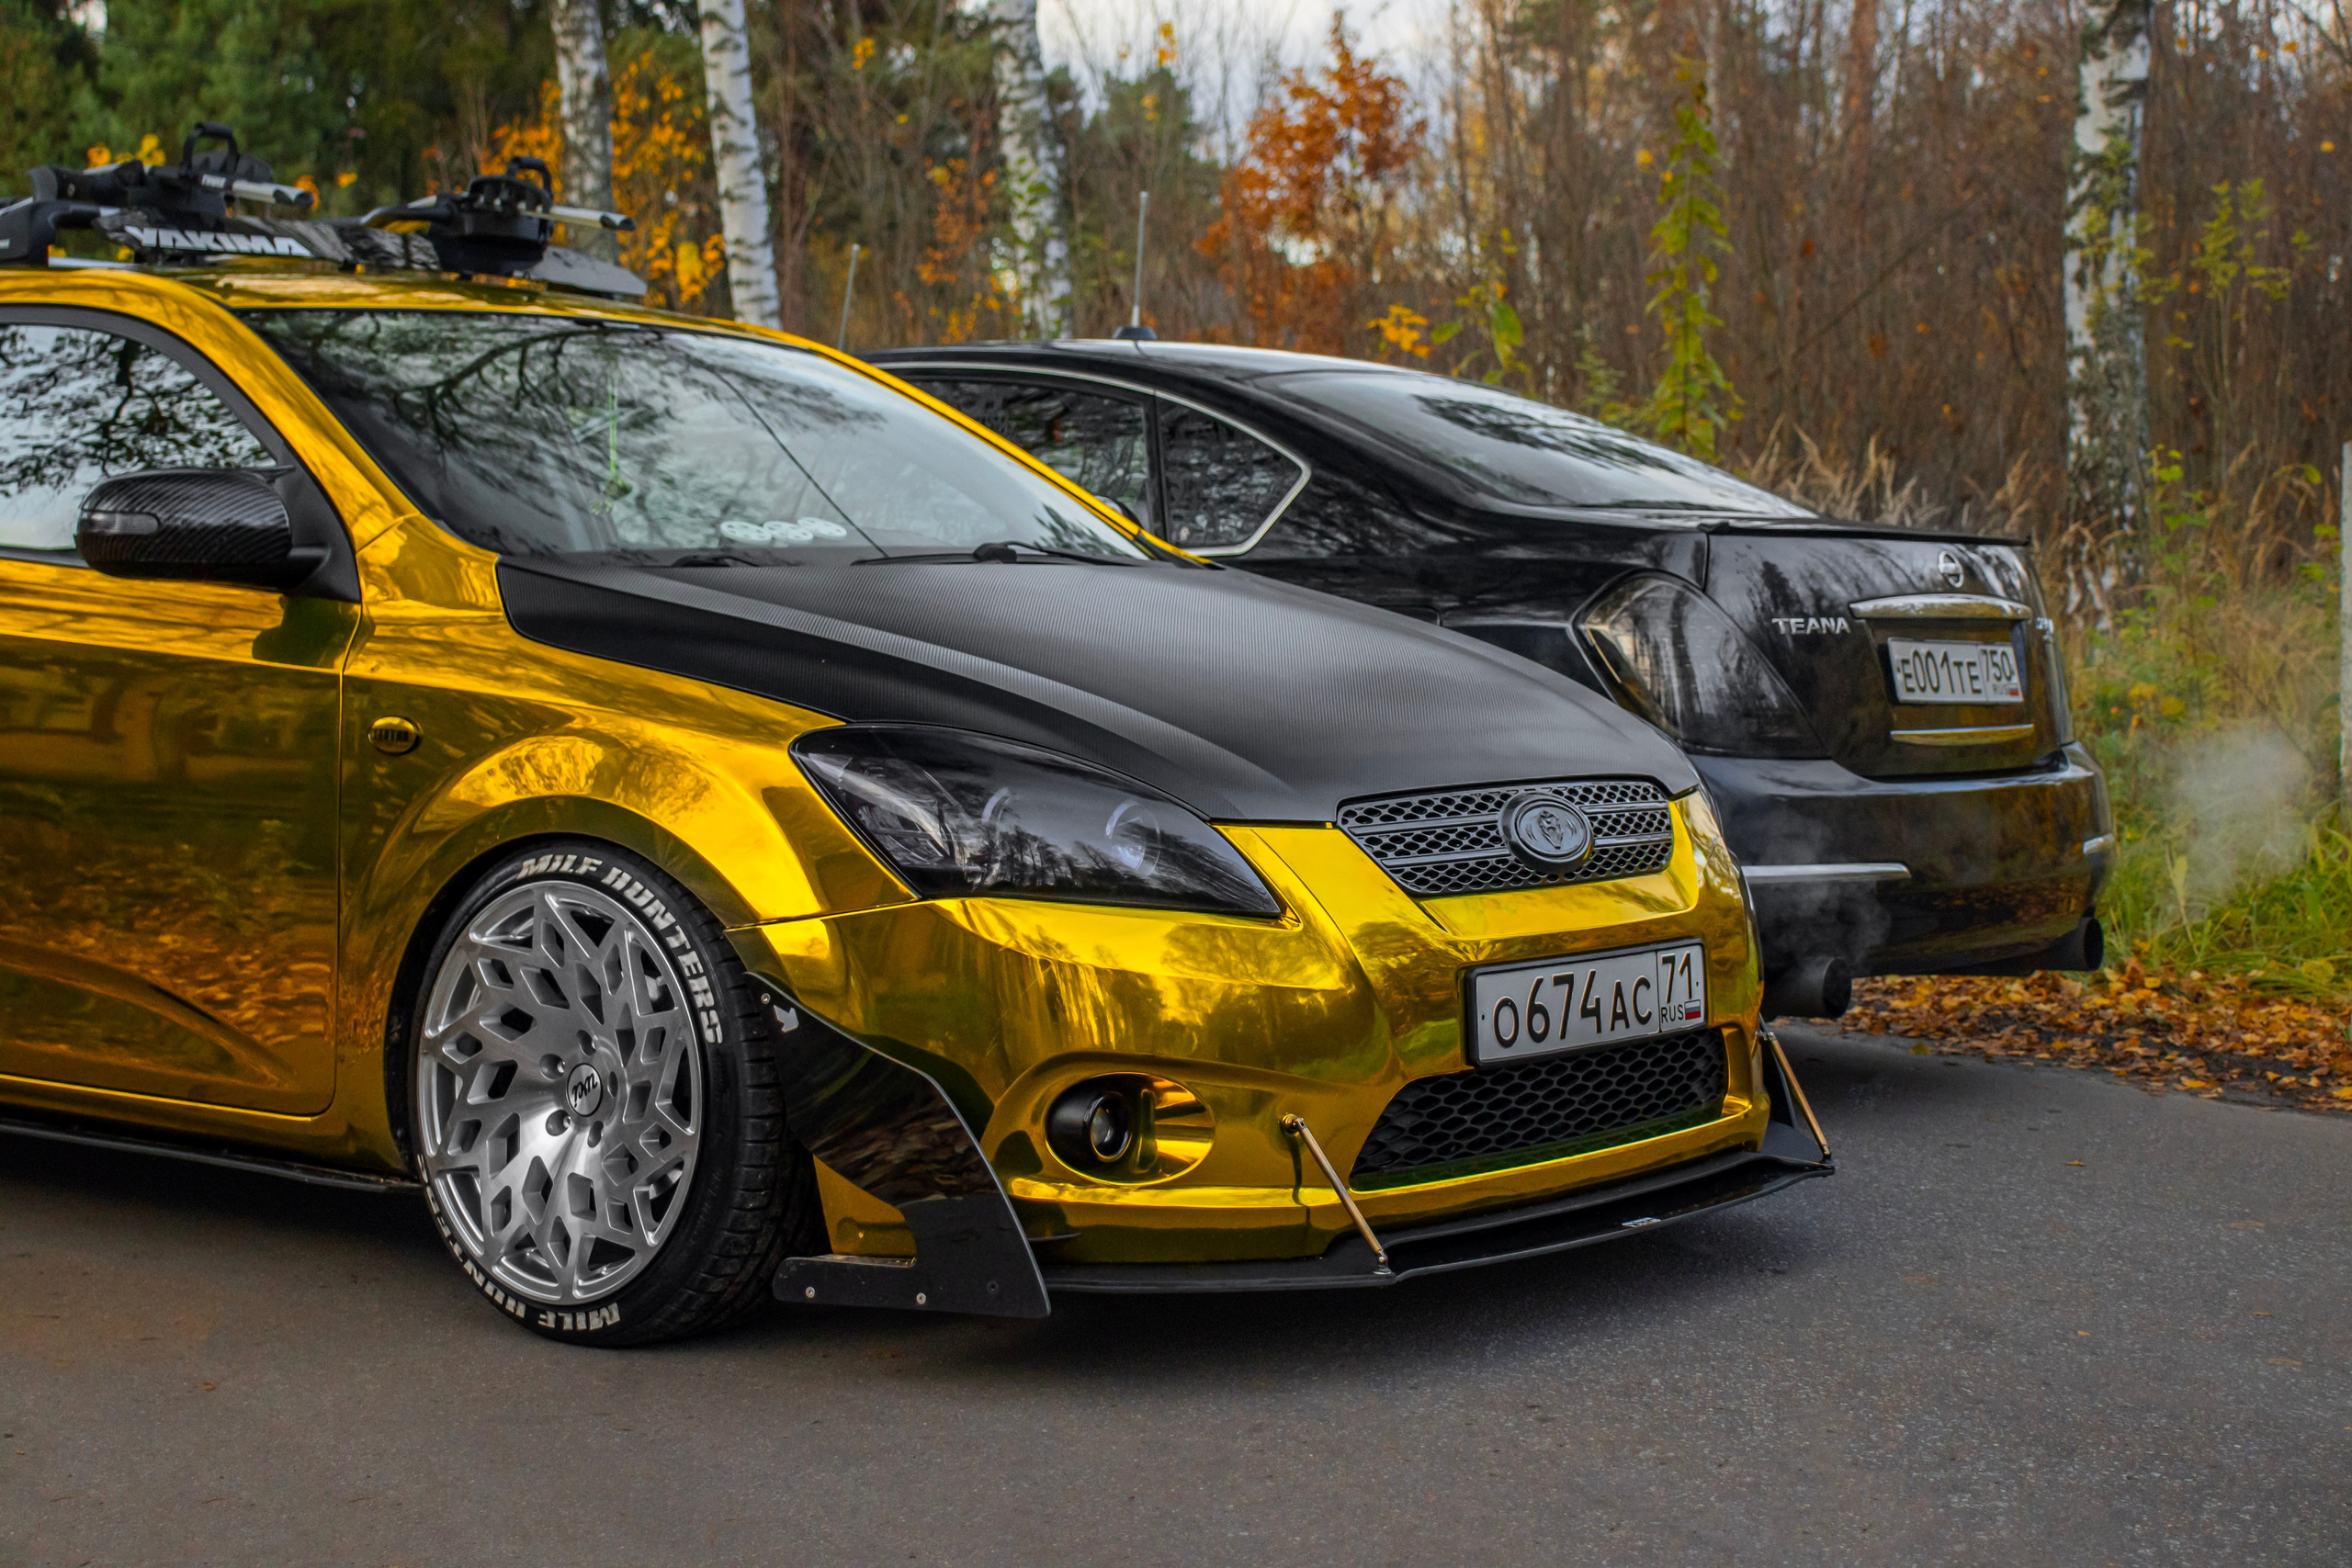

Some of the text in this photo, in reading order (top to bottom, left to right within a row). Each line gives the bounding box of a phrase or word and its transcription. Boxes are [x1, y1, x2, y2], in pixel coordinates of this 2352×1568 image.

[124, 225, 313, 257] YAKIMA
[1771, 616, 1851, 635] TEANA
[1900, 648, 2013, 694] E001TE 750
[515, 853, 724, 1045] MILF HUNTERS
[1493, 951, 1692, 1049] O674AC 71
[1660, 1007, 1684, 1024] RUS
[537, 1302, 621, 1331] MILF
